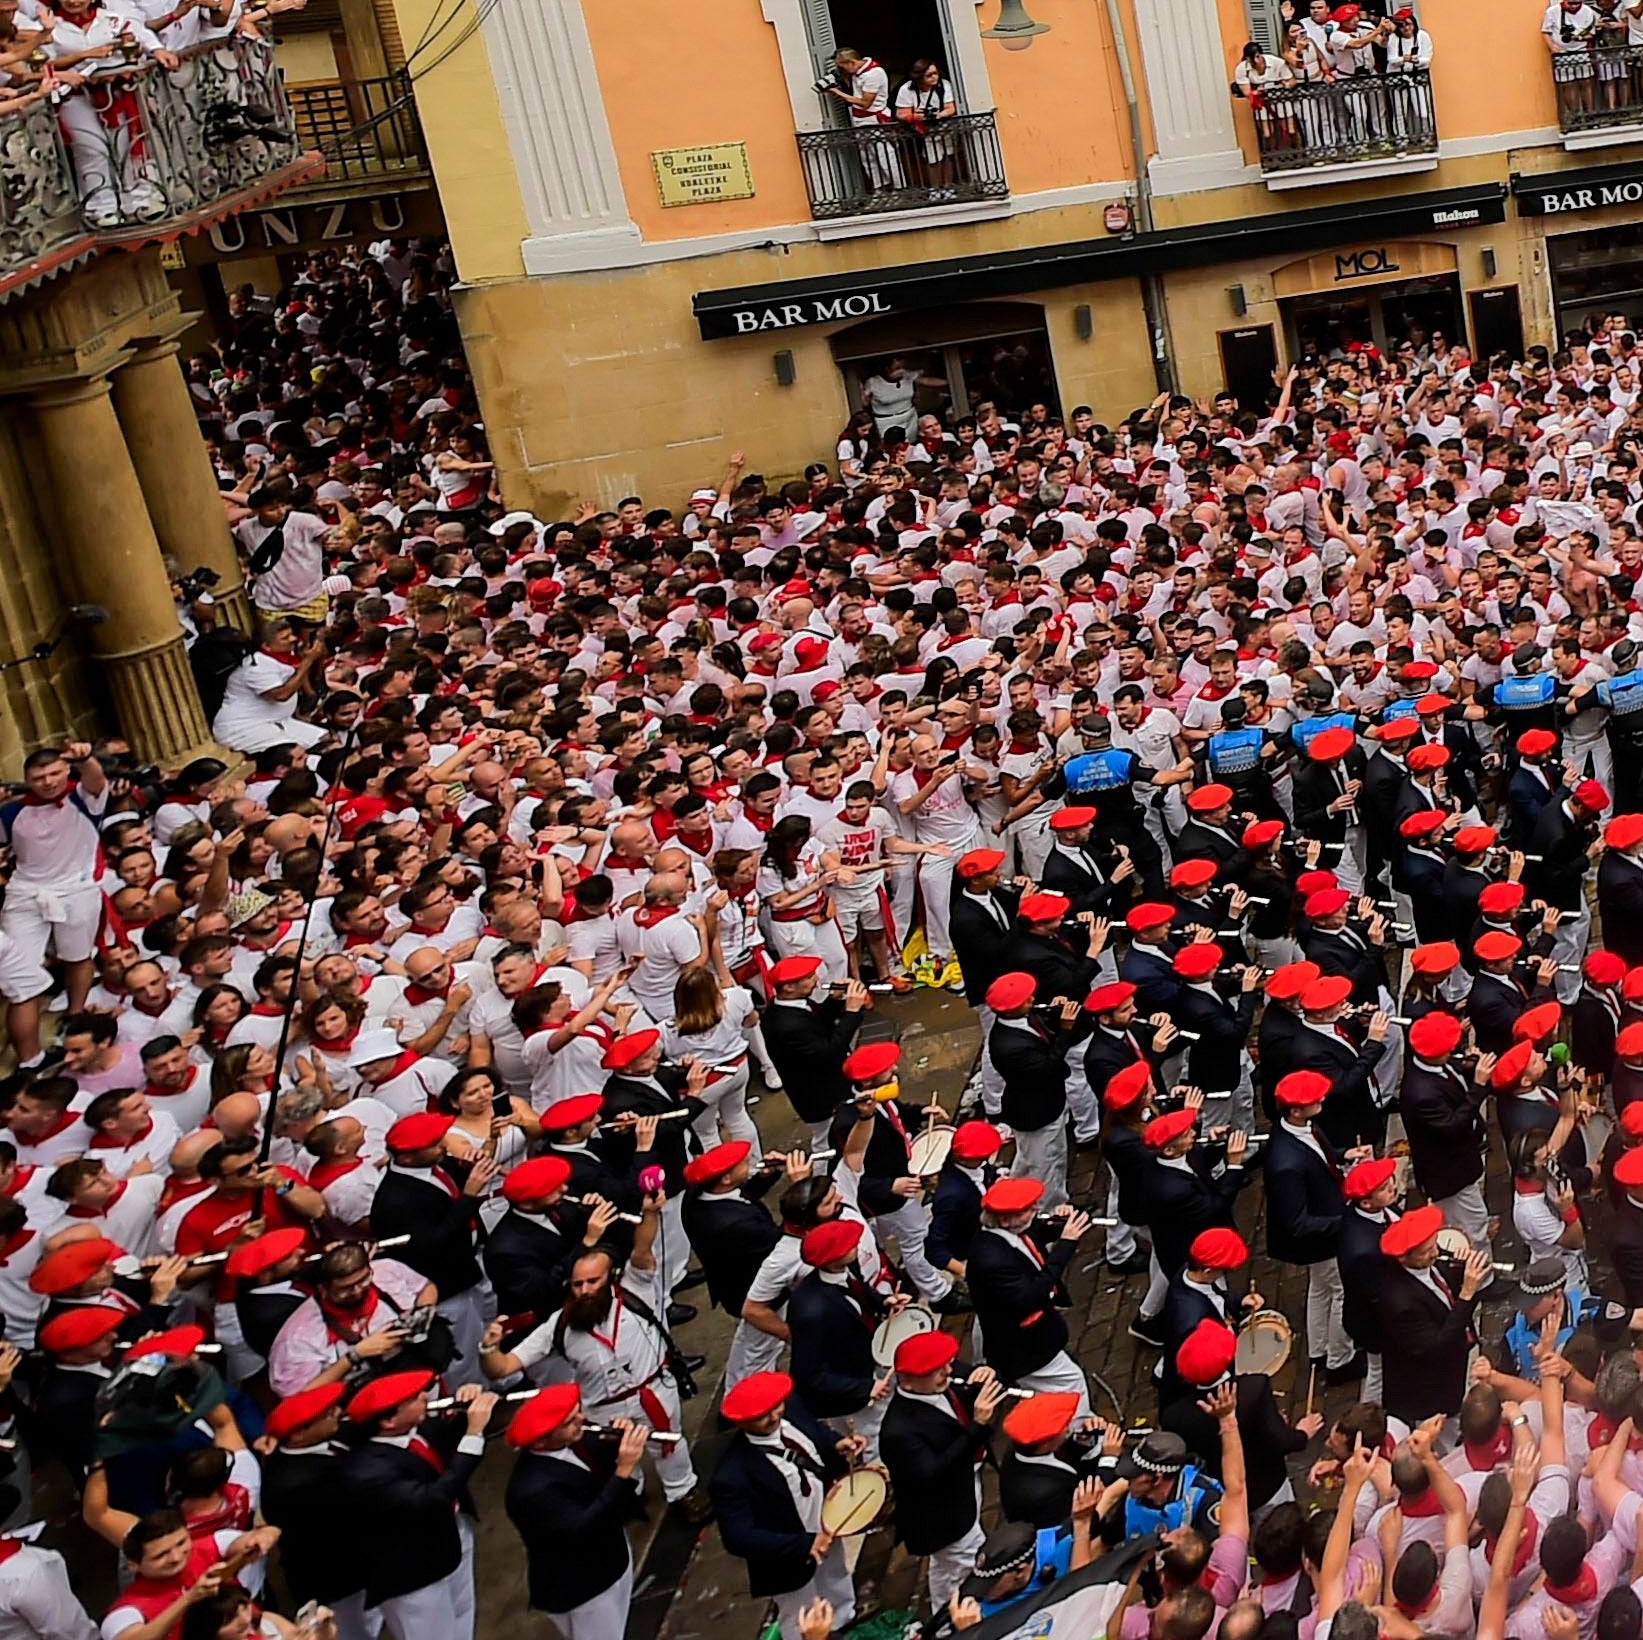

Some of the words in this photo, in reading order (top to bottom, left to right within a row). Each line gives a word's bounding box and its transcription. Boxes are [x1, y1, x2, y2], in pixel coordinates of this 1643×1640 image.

[686, 153, 713, 164] PLAZA
[692, 185, 722, 196] PLAZA
[1541, 189, 1597, 214] BAR
[1335, 248, 1398, 275] MOL
[732, 304, 809, 333] BAR
[812, 292, 892, 322] MOL
